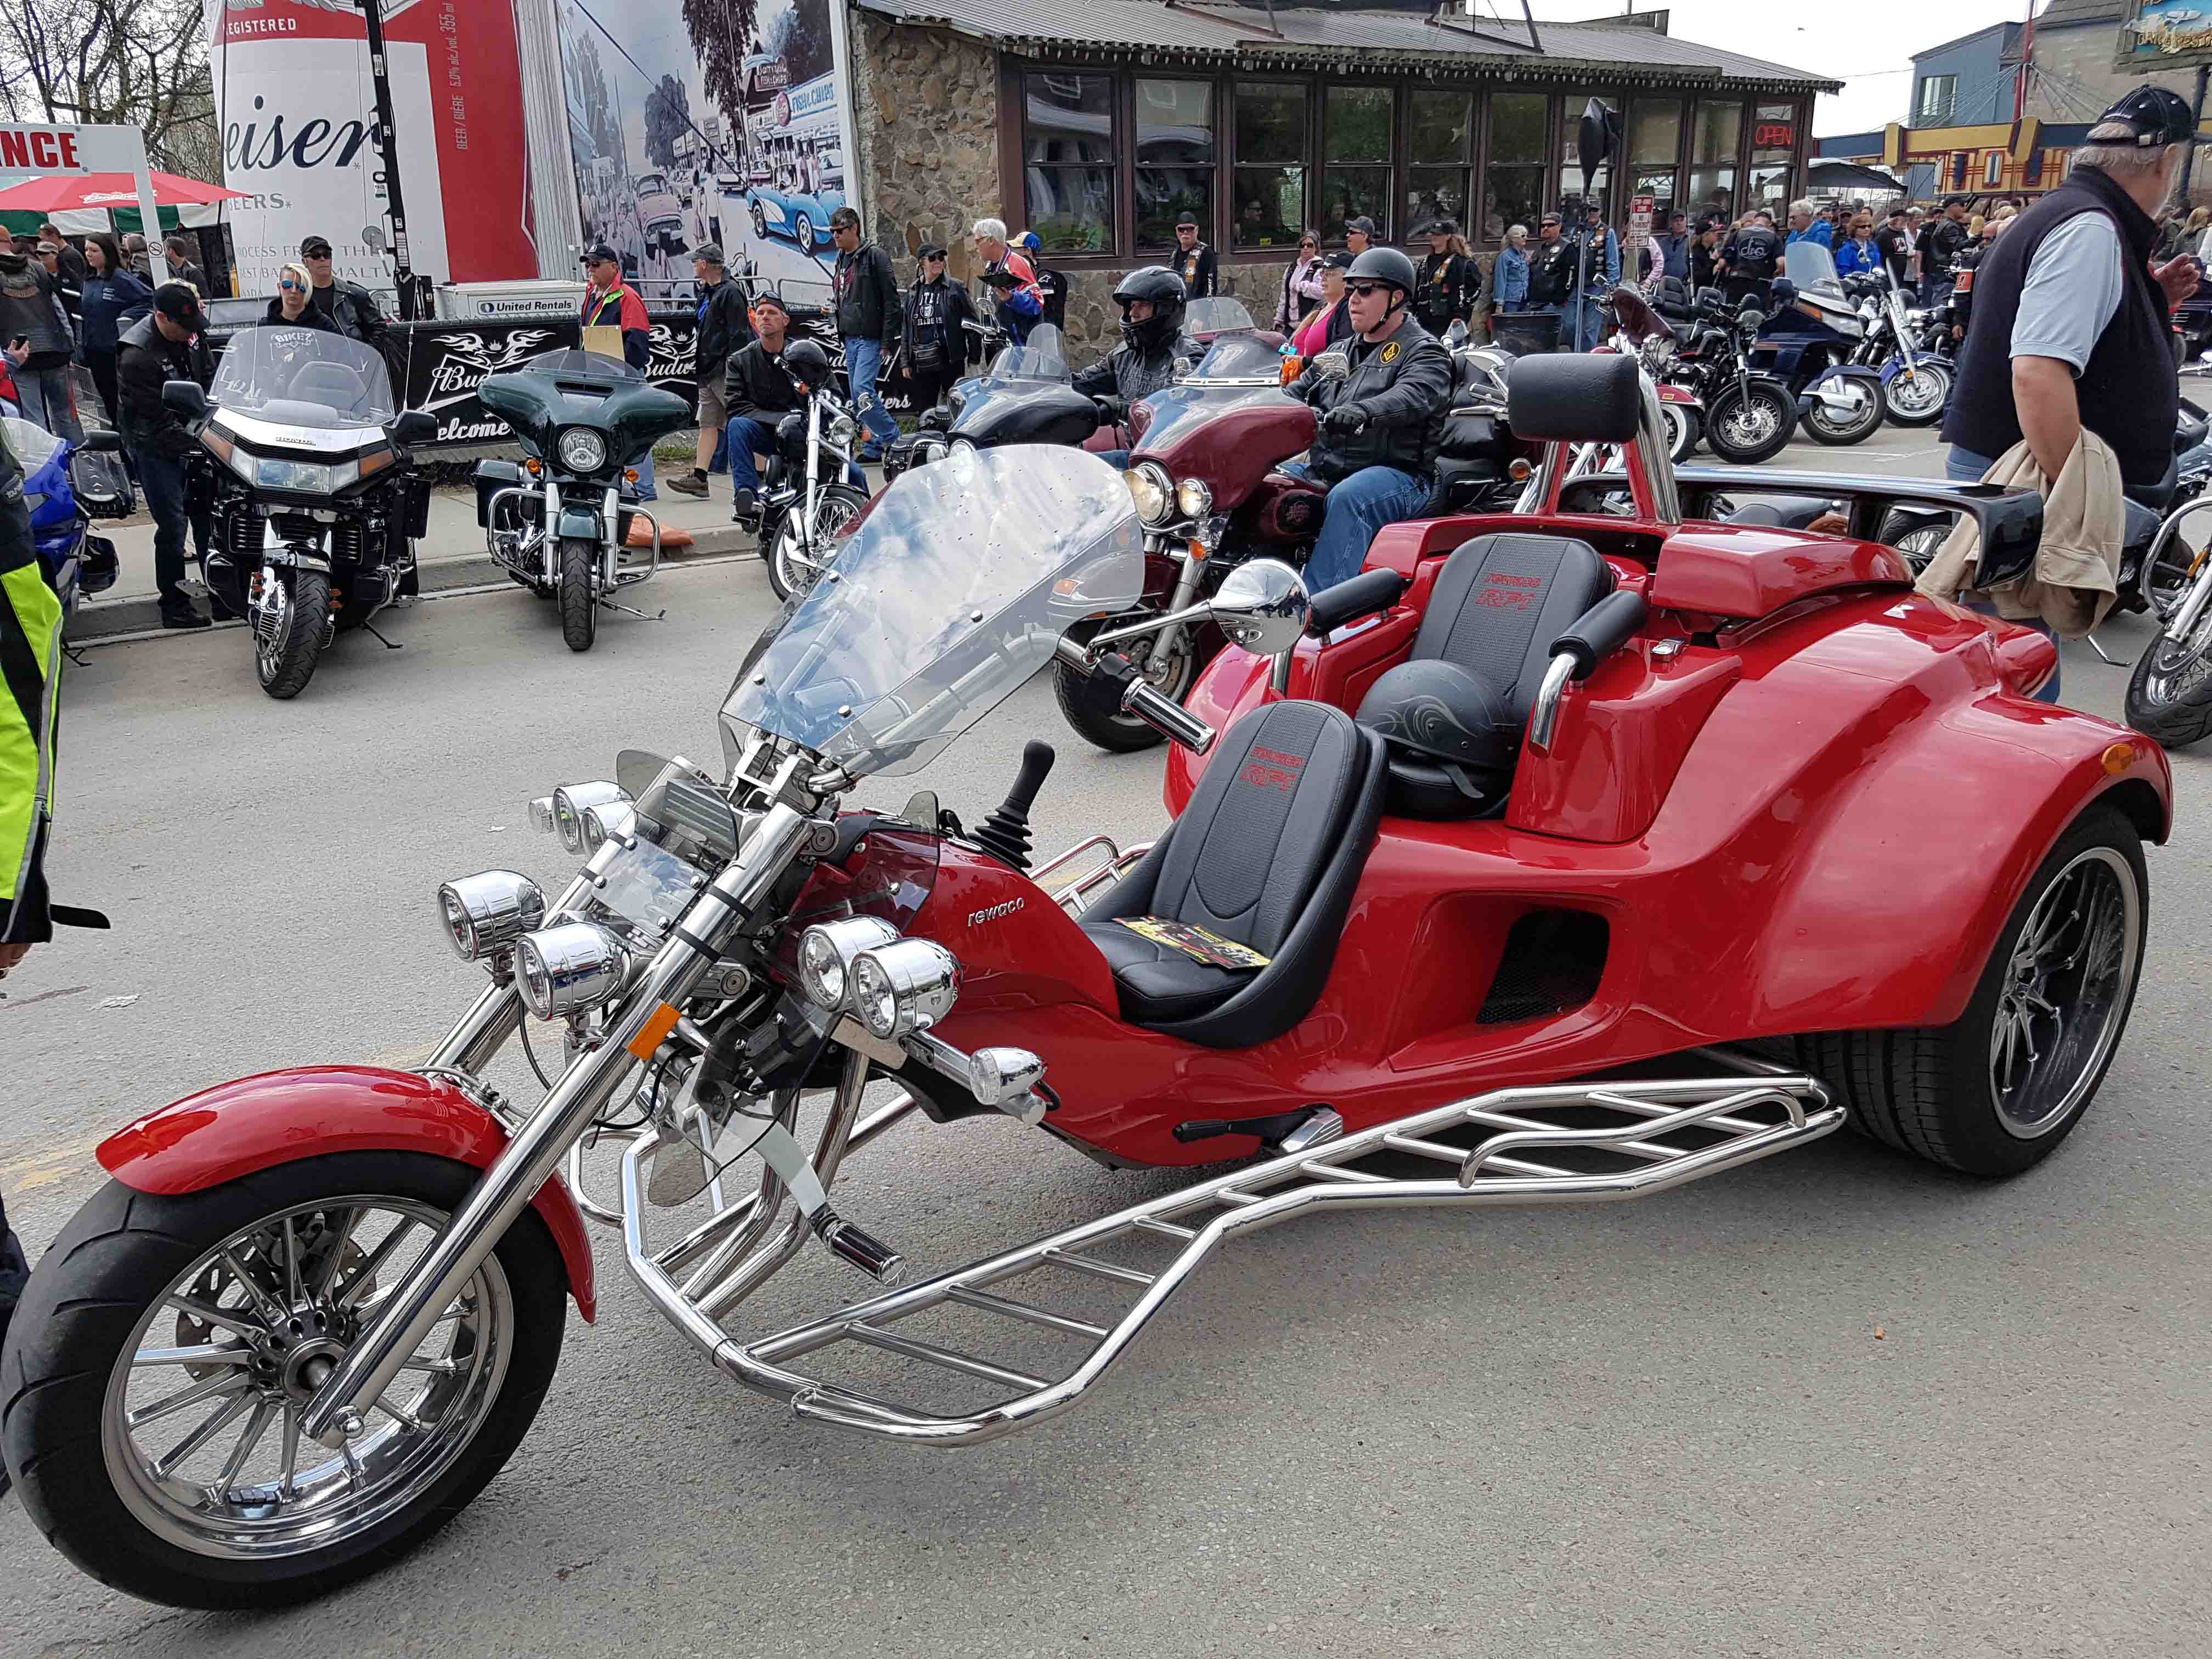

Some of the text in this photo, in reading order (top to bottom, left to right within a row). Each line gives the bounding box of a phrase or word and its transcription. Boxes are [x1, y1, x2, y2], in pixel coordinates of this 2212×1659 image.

[439, 14, 456, 33] 355
[455, 128, 468, 150] BEER
[1755, 126, 1792, 145] OPEN
[0, 131, 81, 168] NCE
[284, 245, 303, 257] FR
[496, 301, 572, 312] United Rentals
[437, 417, 511, 441] elcome
[276, 437, 316, 446] HONDA
[968, 897, 1025, 927] rewaco
